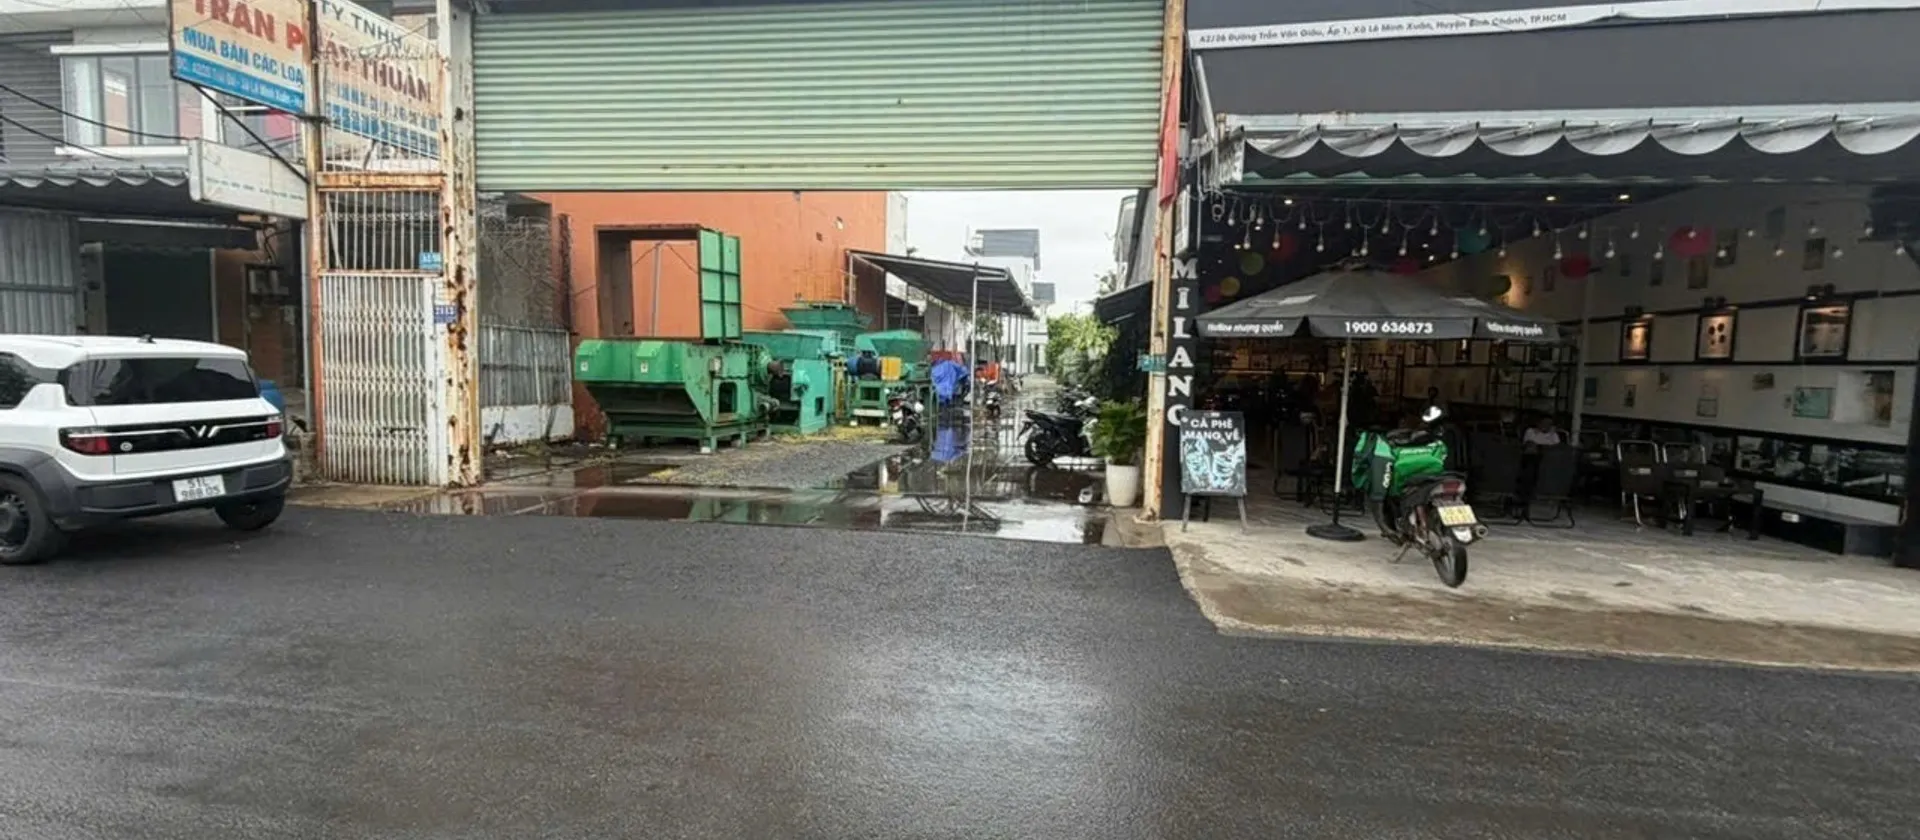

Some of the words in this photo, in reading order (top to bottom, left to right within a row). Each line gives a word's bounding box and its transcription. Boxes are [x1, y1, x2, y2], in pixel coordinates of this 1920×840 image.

[183, 26, 217, 54] MUA
[220, 40, 249, 66] BÁN
[252, 52, 278, 76] CÁC
[1344, 321, 1378, 334] 1900
[1381, 321, 1434, 334] 636873
[1211, 417, 1233, 429] PHÊ
